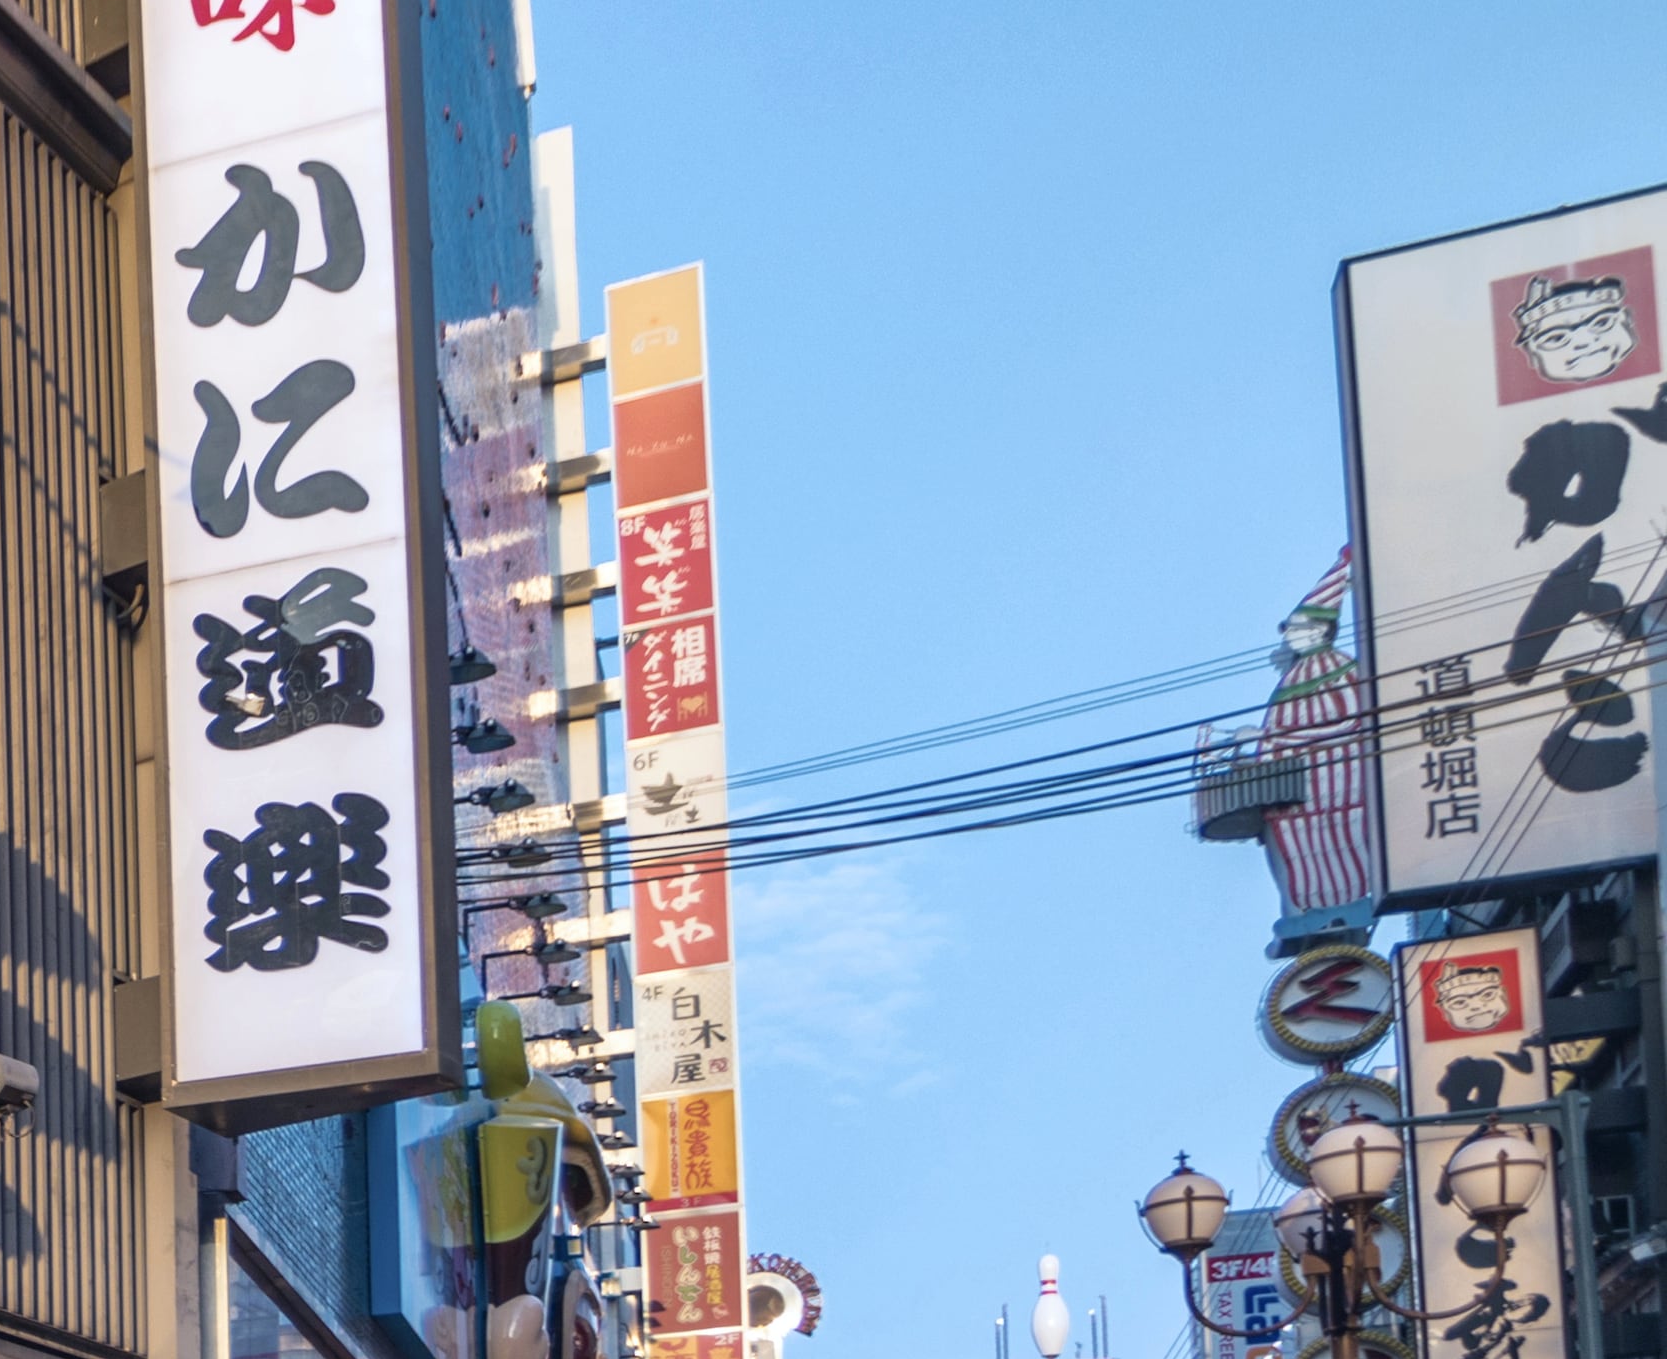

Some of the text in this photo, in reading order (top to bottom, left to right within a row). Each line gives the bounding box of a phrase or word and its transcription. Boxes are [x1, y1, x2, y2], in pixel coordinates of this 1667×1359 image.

[670, 624, 707, 689] 相席
[641, 630, 671, 733] ダイニング
[632, 750, 660, 772] 6F
[1416, 654, 1480, 840] 道頓堀店
[641, 984, 665, 1002] 4F
[670, 986, 727, 1085] 白木屋
[1218, 1291, 1233, 1319] TAX
[714, 1333, 740, 1346] 2F
